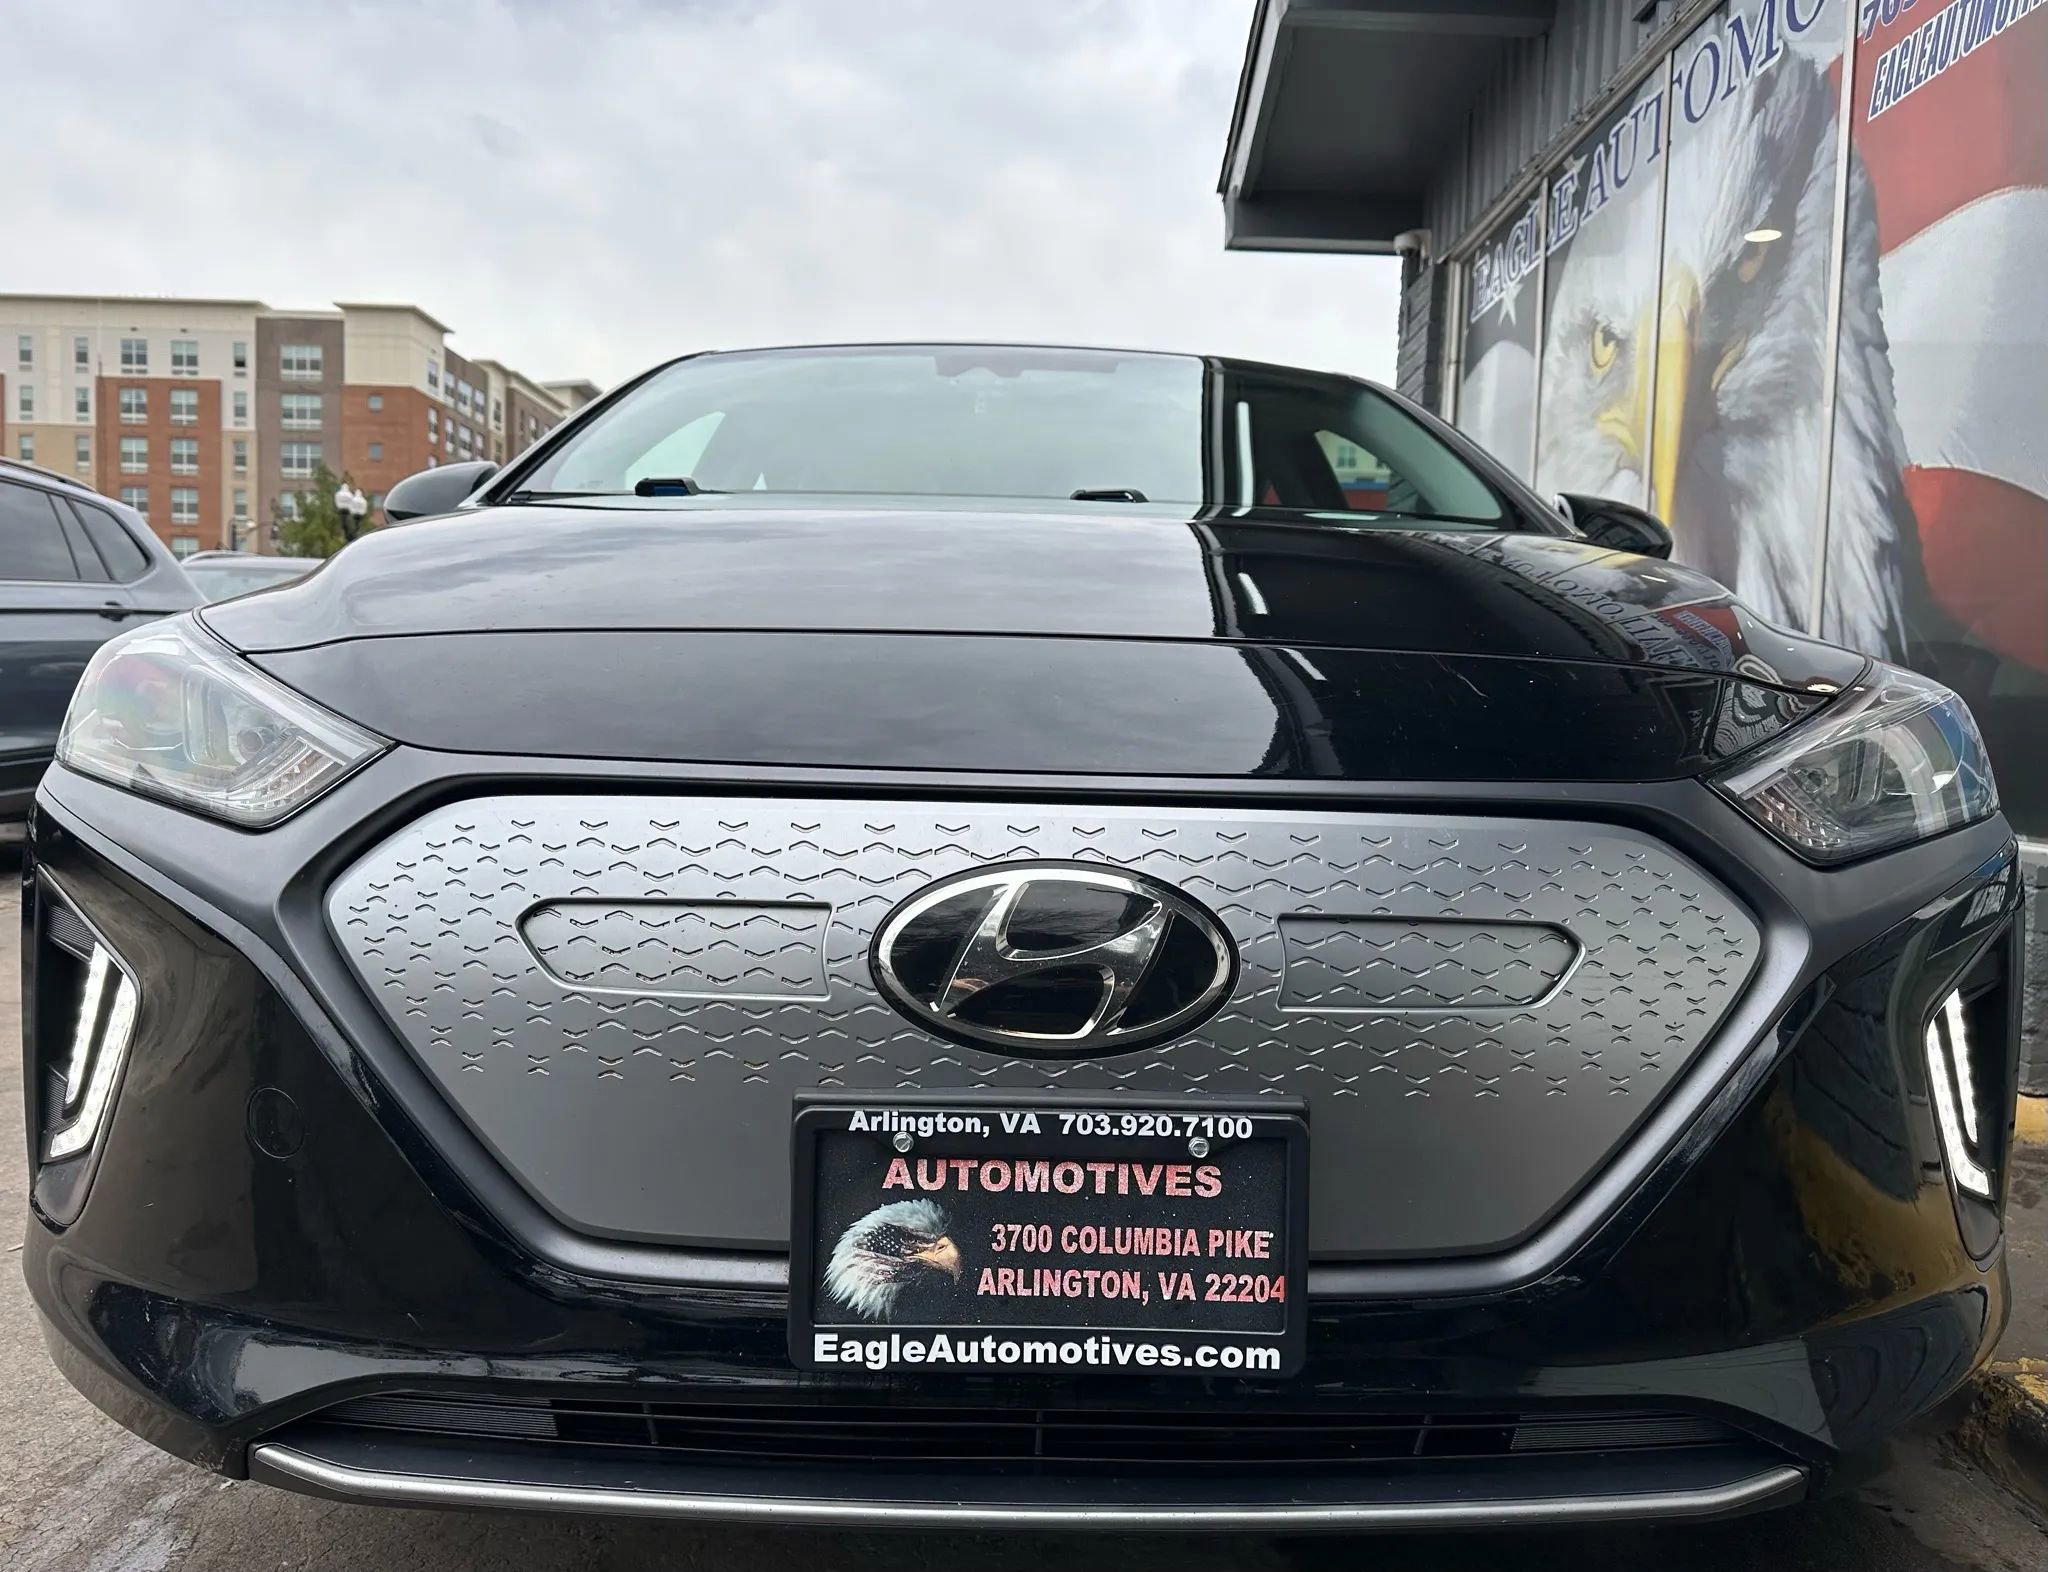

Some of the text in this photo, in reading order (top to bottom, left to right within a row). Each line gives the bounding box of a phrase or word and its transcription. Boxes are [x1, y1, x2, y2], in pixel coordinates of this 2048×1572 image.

[1862, 0, 1919, 44] 70
[1868, 0, 2048, 122] EAGLEAUTOM
[1472, 172, 1581, 322] EAGLE
[848, 1110, 1253, 1139] Arlington, VA 703.920.7100
[882, 1158, 1223, 1198] AUTOMOTIVES
[991, 1223, 1272, 1259] 3700 COLUMBIA PIKE
[977, 1268, 1286, 1306] ARLINGTON, VA 22204
[813, 1333, 1281, 1370] EagleAutomotives.com
